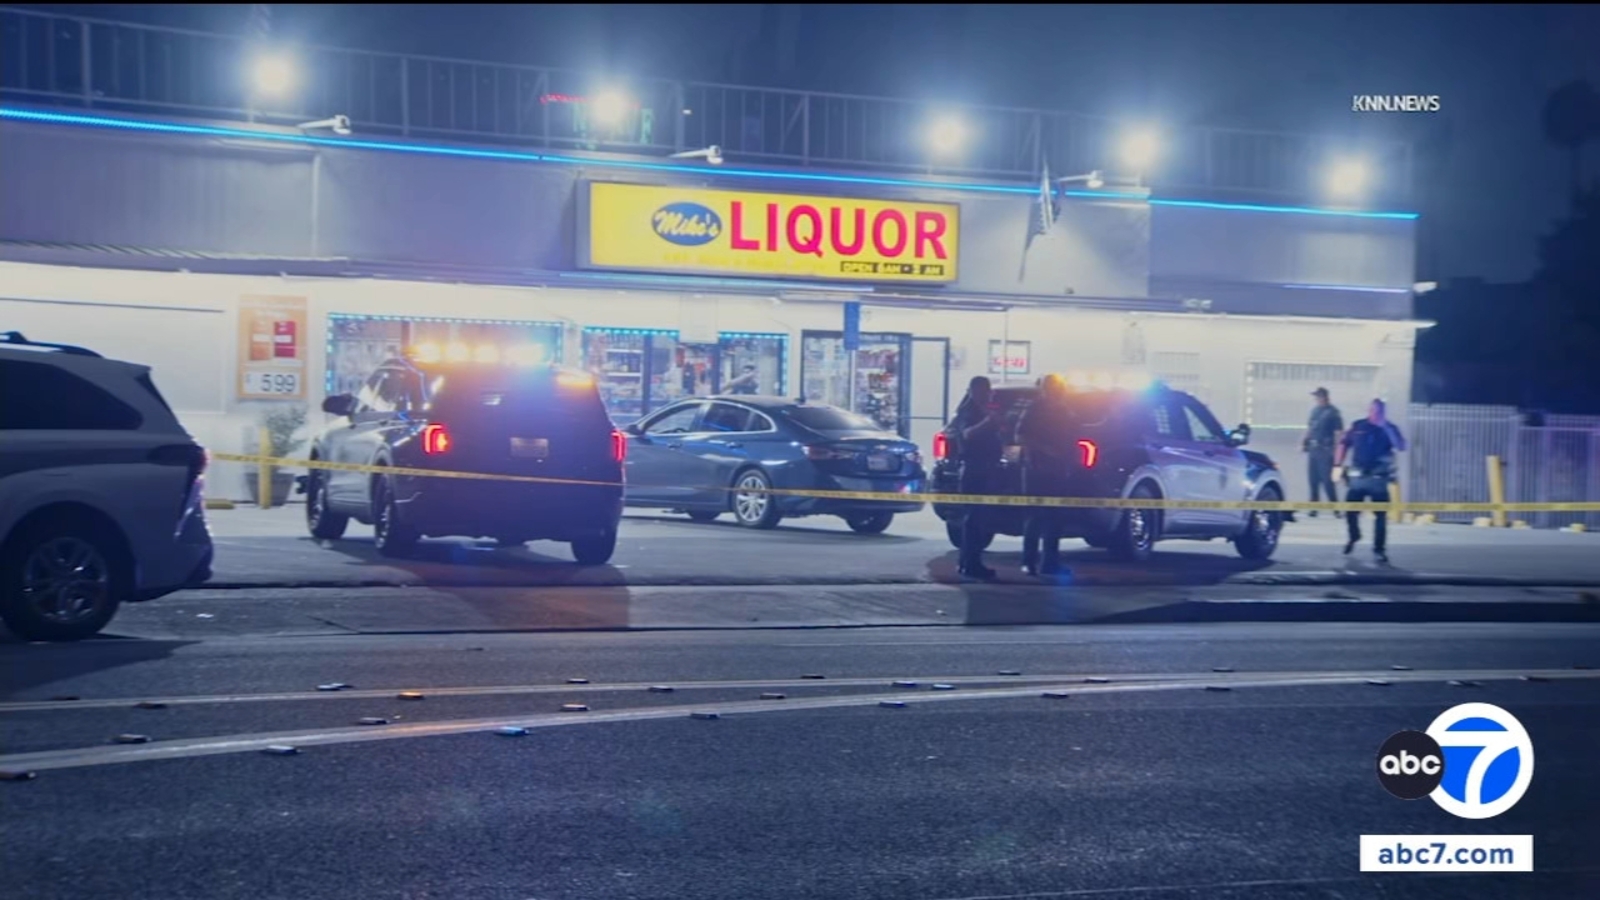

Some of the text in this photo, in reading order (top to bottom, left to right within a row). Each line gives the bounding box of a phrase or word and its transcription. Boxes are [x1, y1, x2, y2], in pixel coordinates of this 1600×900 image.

[654, 201, 948, 259] Mike's LIQUOR
[842, 261, 874, 273] OPEN
